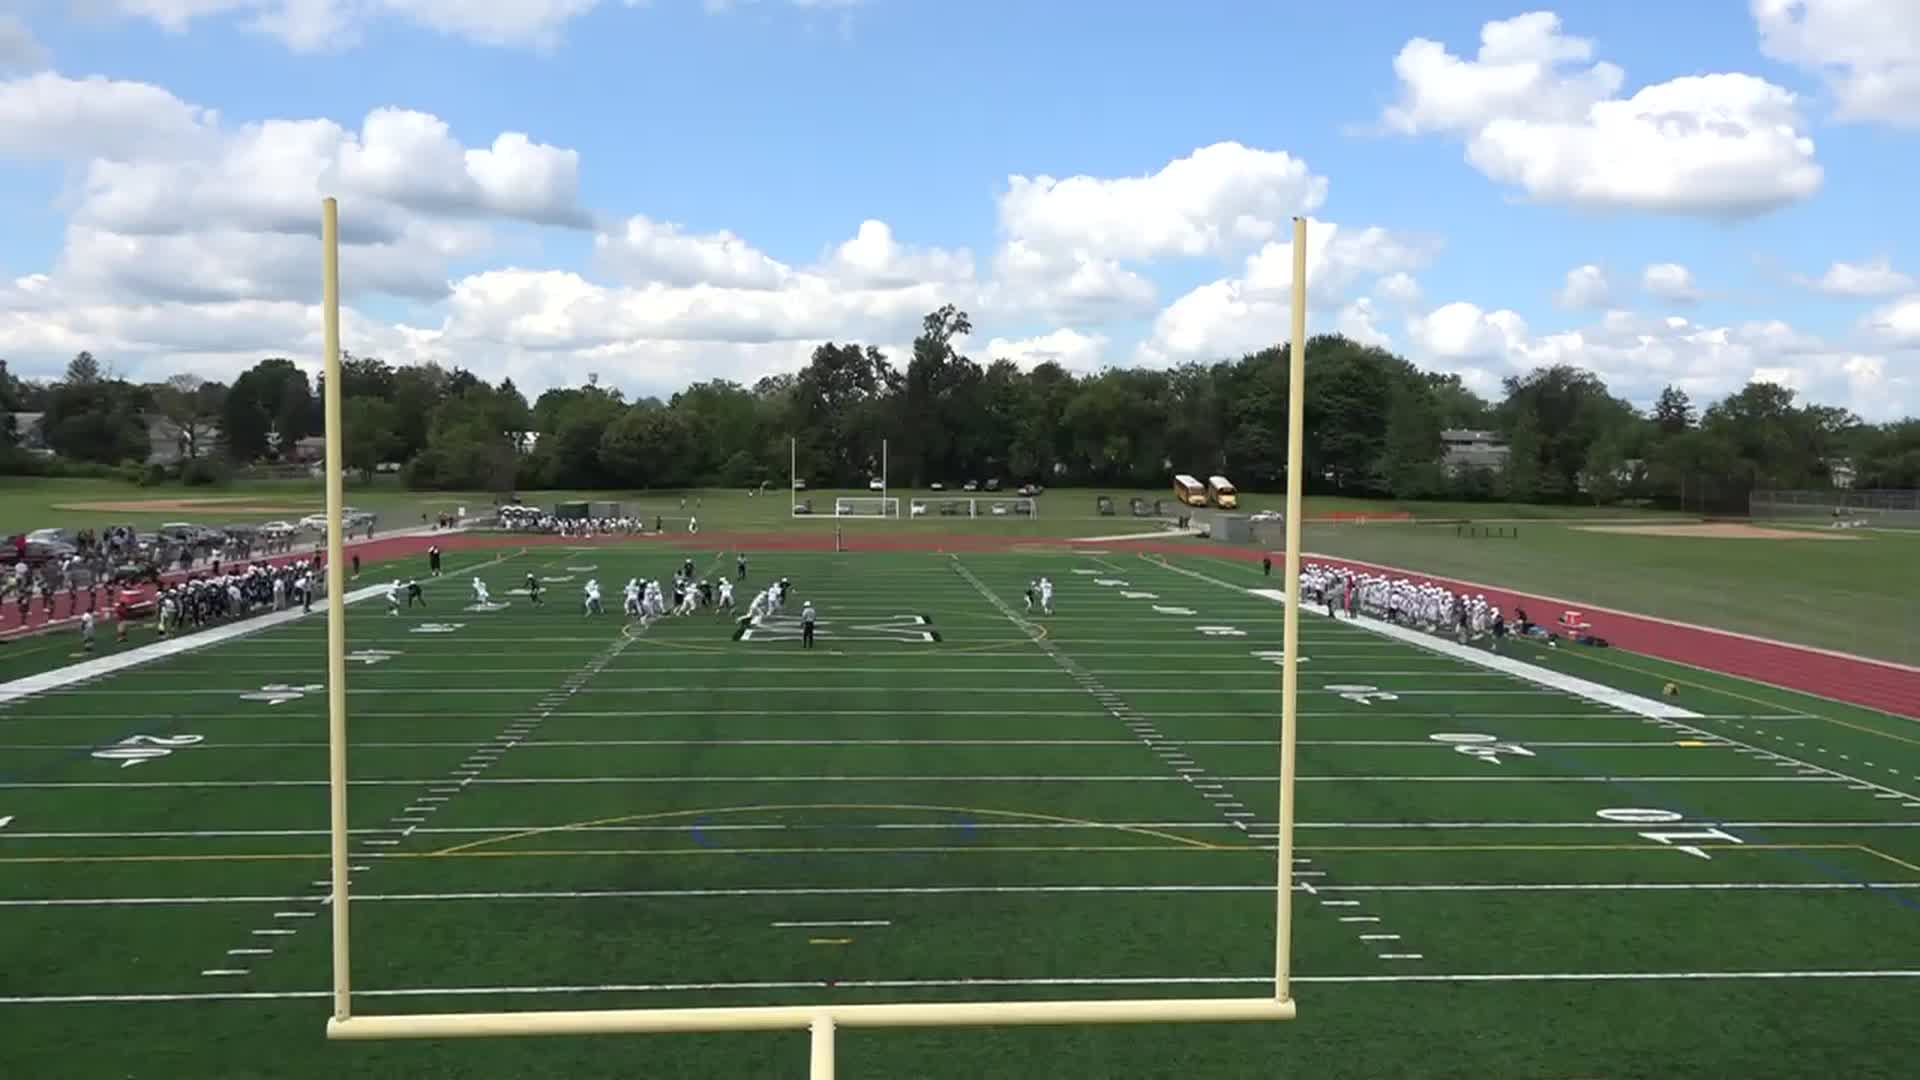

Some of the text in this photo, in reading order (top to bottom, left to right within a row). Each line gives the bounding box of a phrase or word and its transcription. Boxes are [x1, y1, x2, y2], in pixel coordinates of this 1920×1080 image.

[92, 735, 204, 759] 20
[1429, 733, 1537, 757] 20
[1595, 807, 1744, 845] 10
